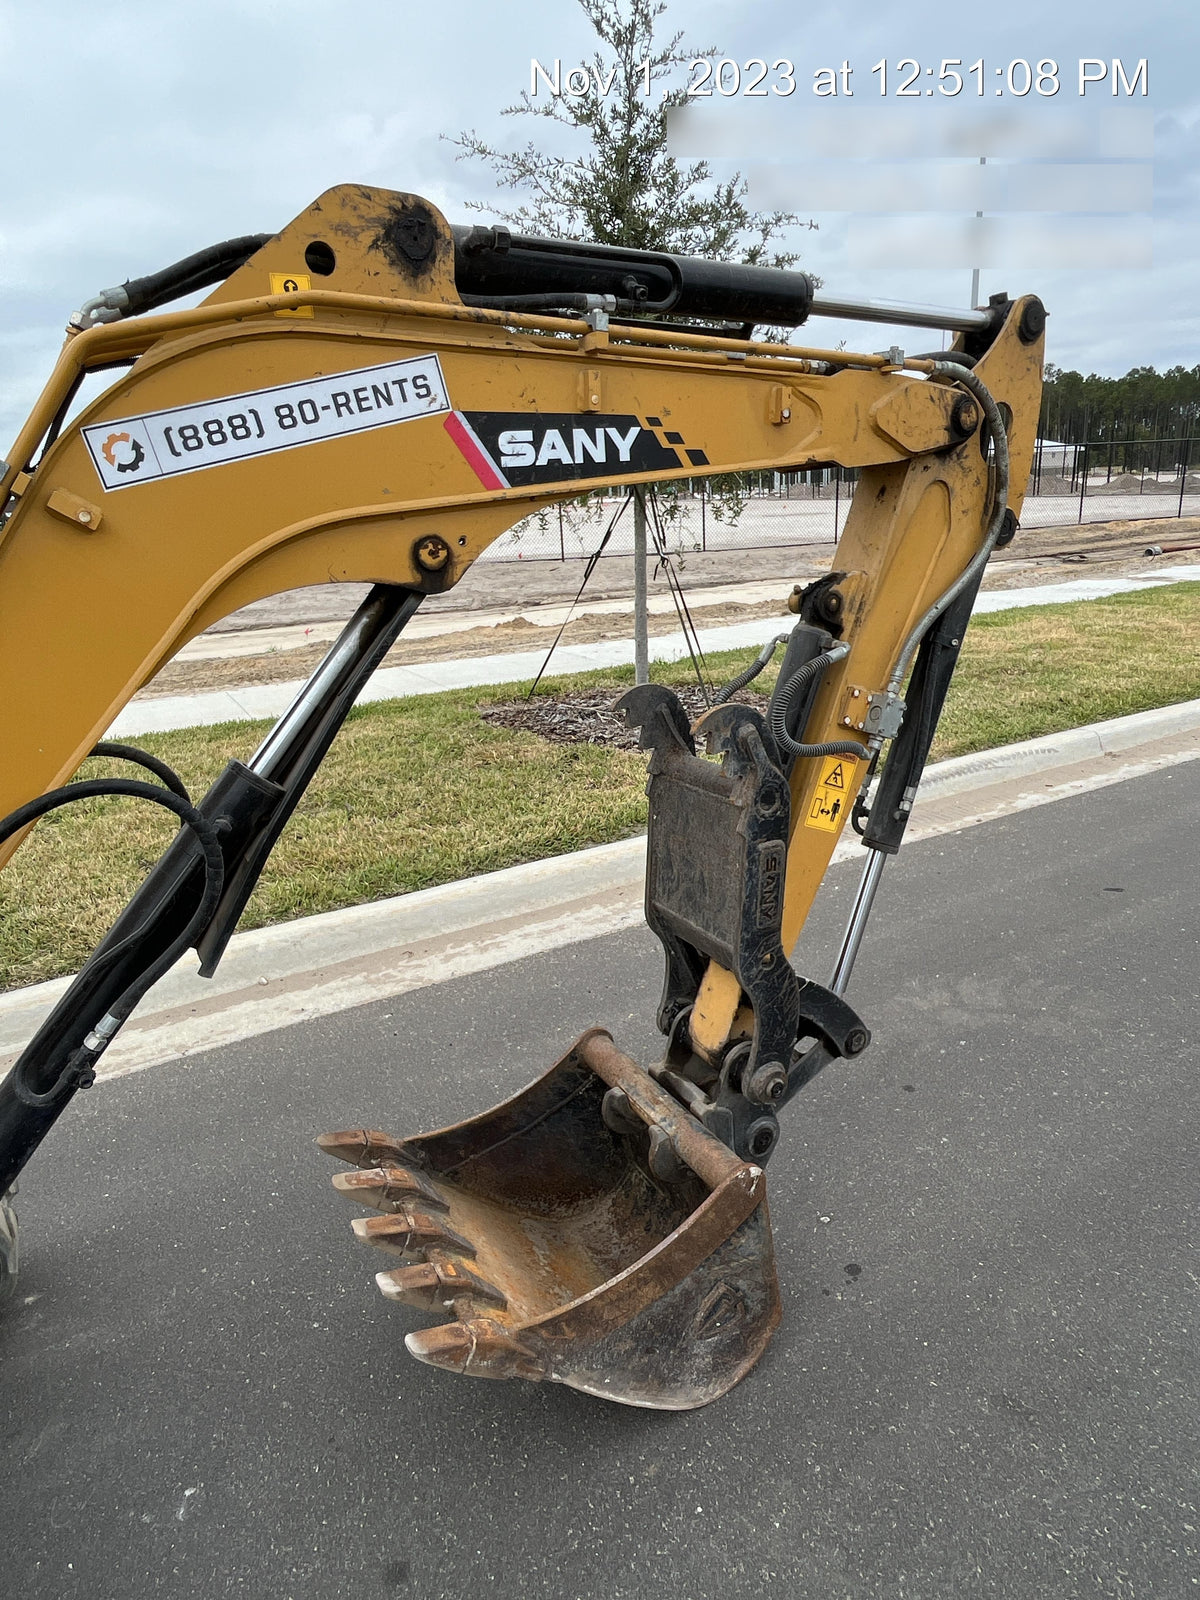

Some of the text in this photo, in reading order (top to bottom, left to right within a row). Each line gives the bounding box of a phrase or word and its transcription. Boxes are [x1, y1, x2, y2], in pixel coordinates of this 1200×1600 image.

[163, 374, 432, 457] (888) 80-RENTS
[498, 426, 641, 468] SANY
[763, 857, 777, 920] SANY
